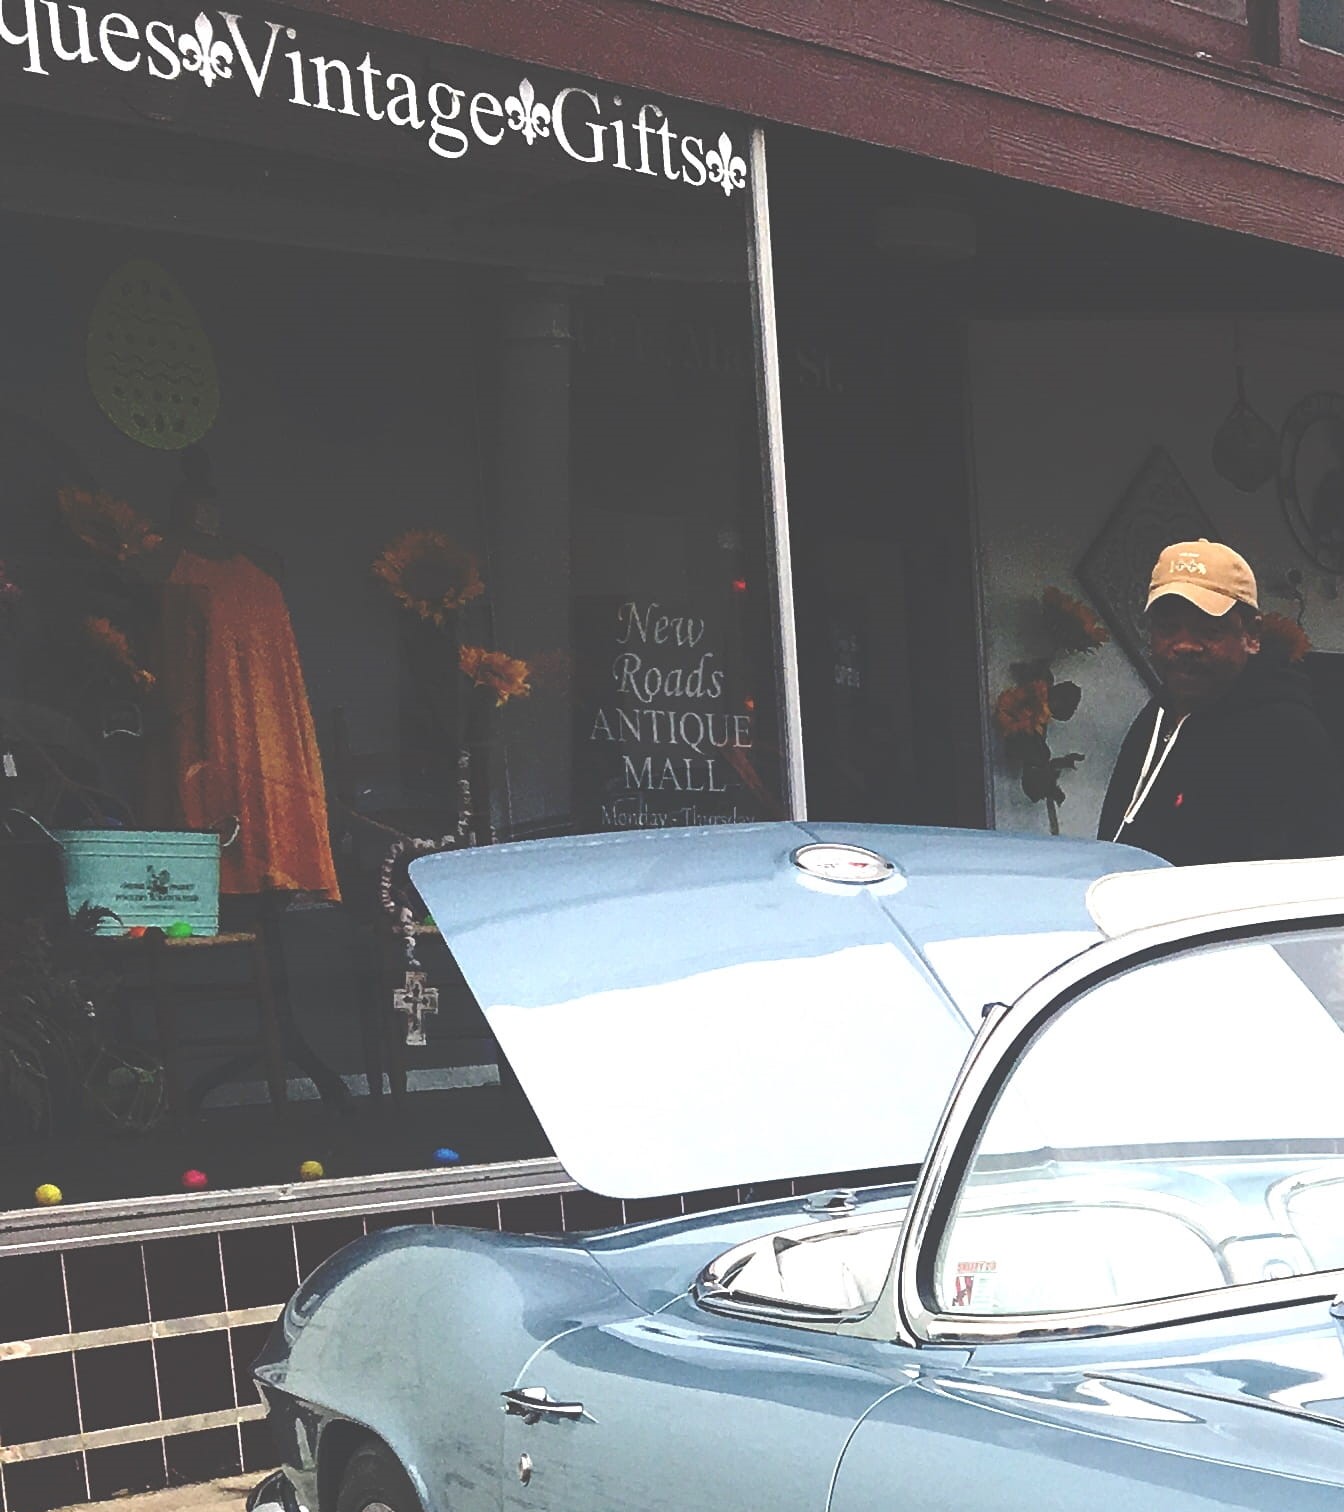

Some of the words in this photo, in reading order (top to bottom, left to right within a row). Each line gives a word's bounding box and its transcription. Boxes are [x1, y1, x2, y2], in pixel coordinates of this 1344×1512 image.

[217, 11, 505, 159] Vintage
[551, 86, 707, 188] Gifts
[616, 601, 705, 648] New
[612, 652, 725, 704] Roads
[589, 707, 754, 756] ANTIQUE
[621, 754, 728, 793] MALL
